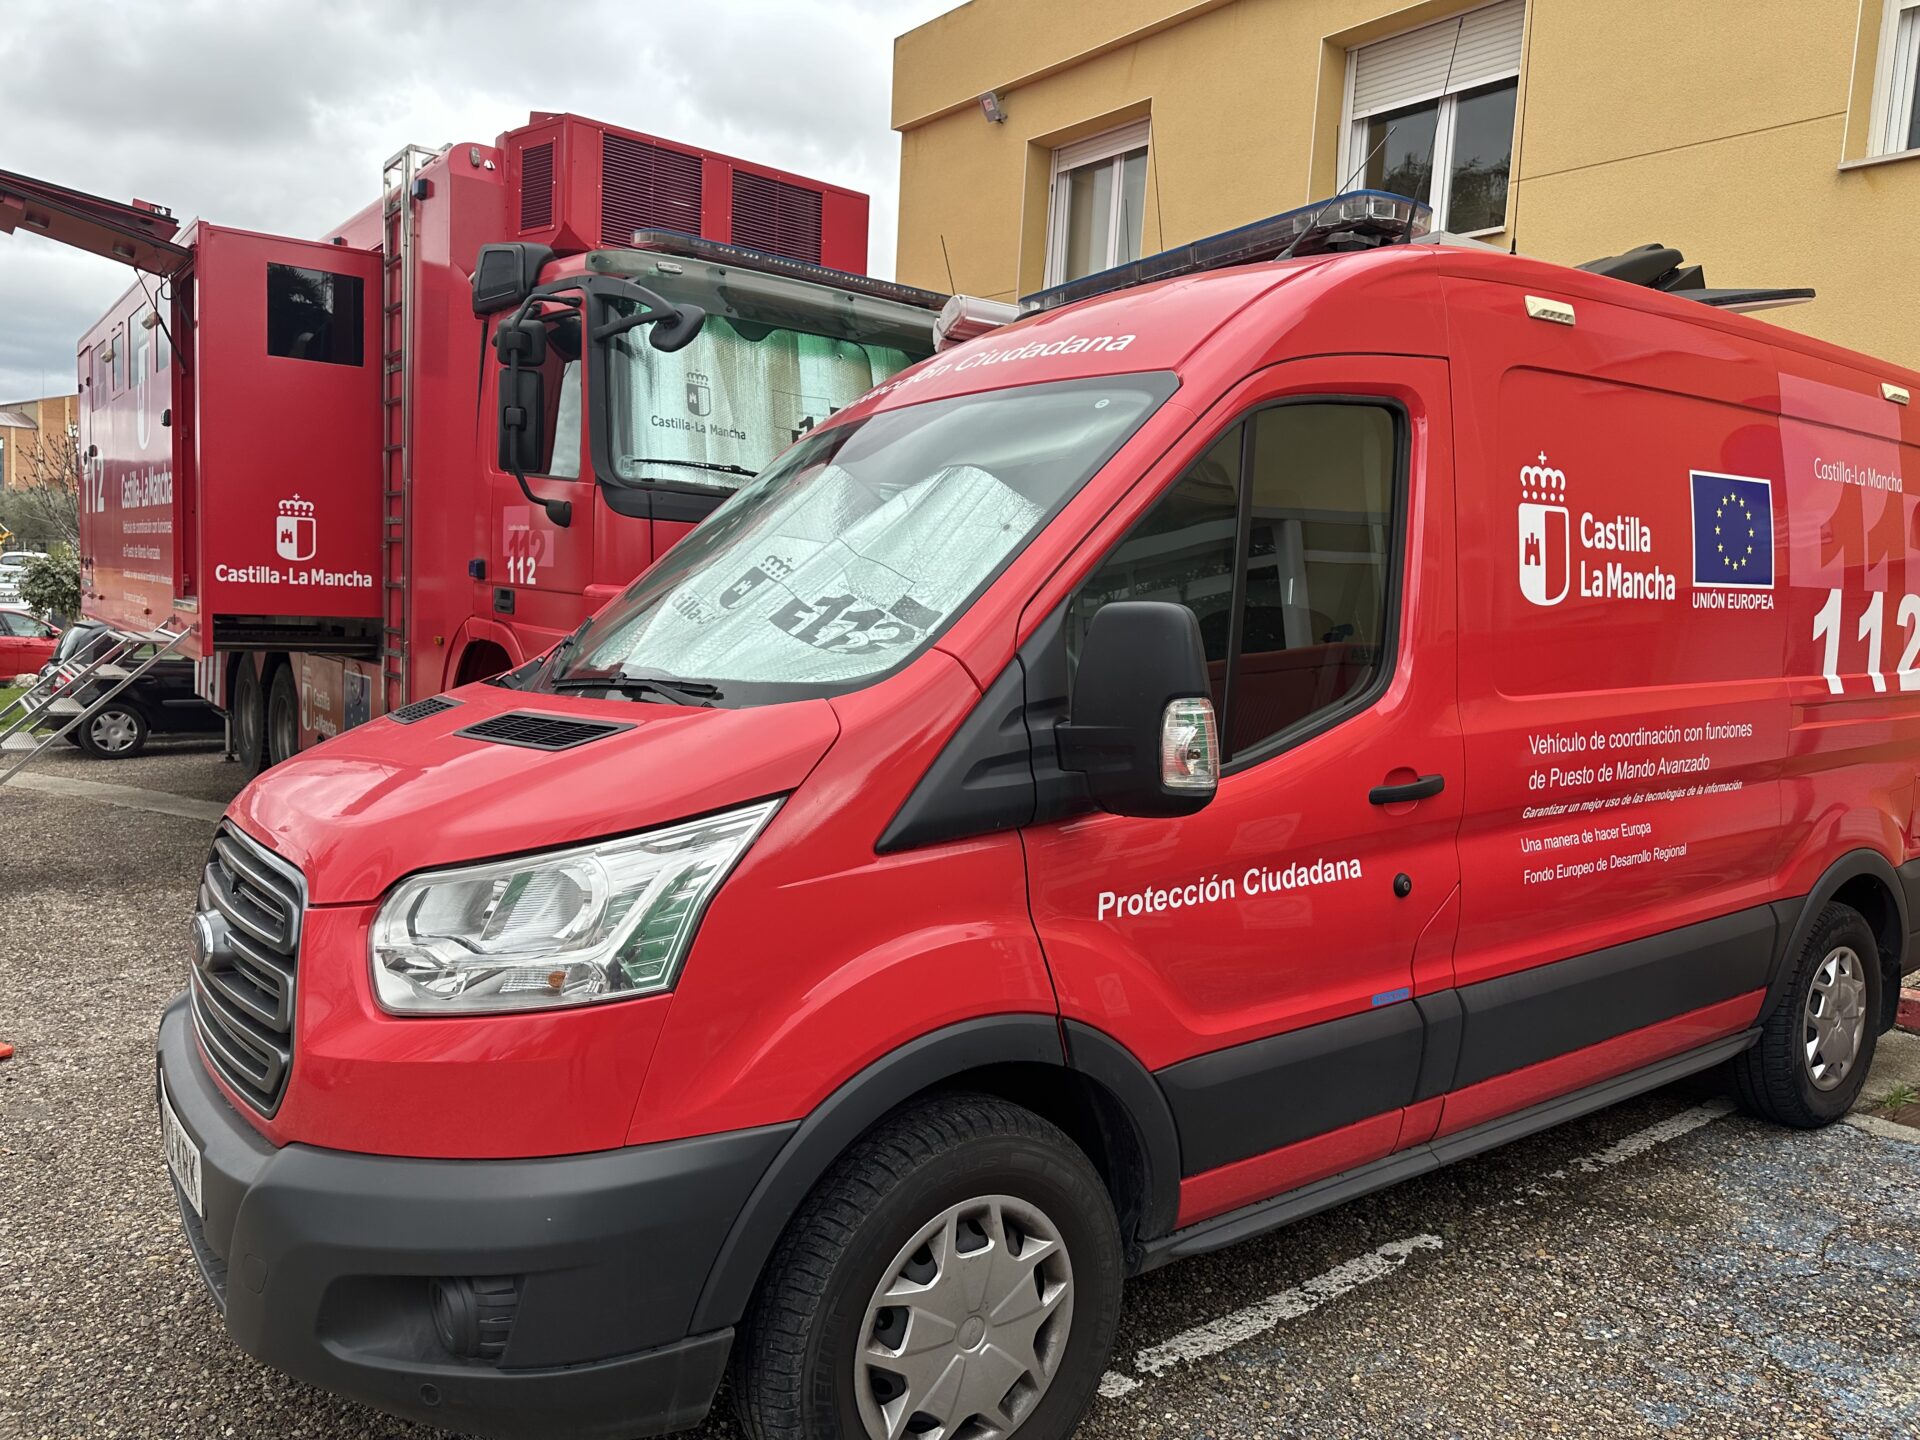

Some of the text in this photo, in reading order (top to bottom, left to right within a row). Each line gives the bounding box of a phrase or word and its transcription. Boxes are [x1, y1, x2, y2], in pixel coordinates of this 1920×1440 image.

[954, 334, 1136, 372] Ciudadana
[651, 415, 746, 440] Castilla-La Mancha
[1814, 457, 1903, 493] Castilla-La Mancha
[1580, 512, 1651, 553] Castilla
[311, 568, 373, 588] Mancha
[507, 555, 536, 585] 112
[1580, 561, 1676, 601] La Mancha
[1692, 588, 1774, 610] UNIÓN EUROPEA
[1812, 588, 1920, 694] 112
[1529, 721, 1752, 755] Vehículo de coordinación con funciones
[1529, 753, 1710, 790] de Puesto de Mando Avanzado
[1522, 779, 1743, 819] Garantizar un mejor uso de las tecnologías de la información
[1520, 821, 1652, 853] Una manera de hacer Europa
[1524, 842, 1687, 885] Fondo Europeo de Desarrollo Regional
[1098, 858, 1362, 920] Protección Ciudadana
